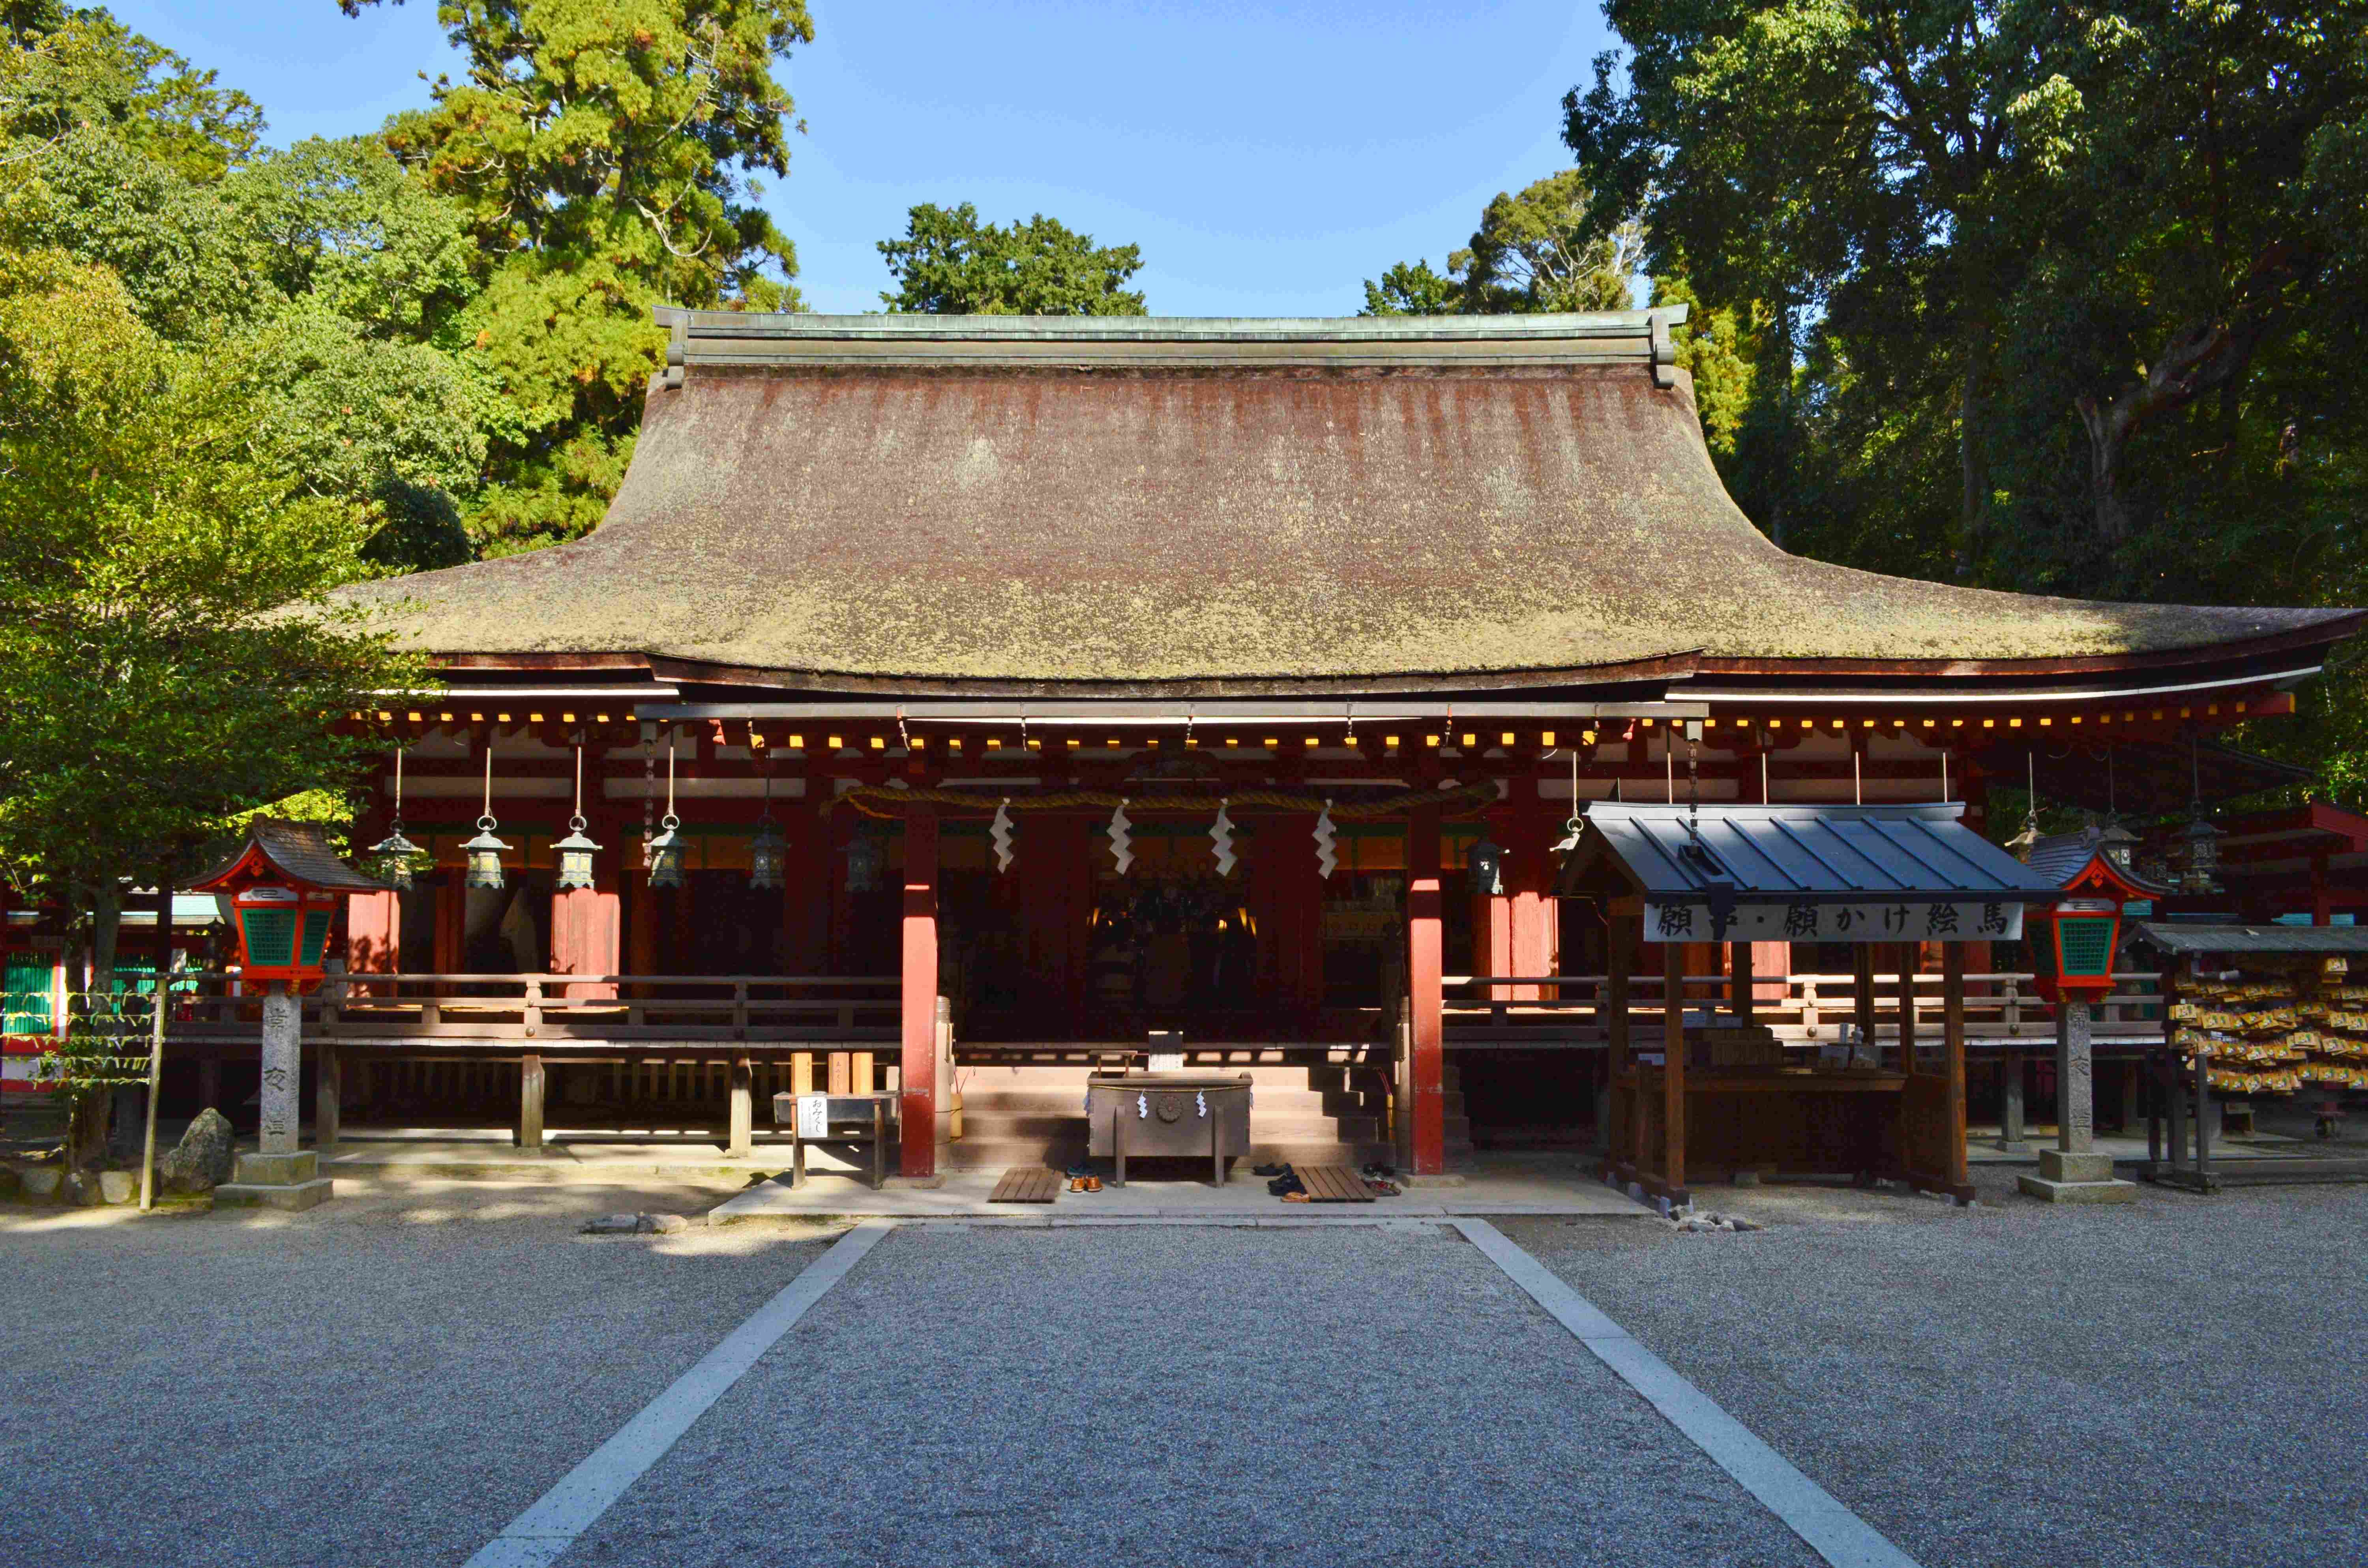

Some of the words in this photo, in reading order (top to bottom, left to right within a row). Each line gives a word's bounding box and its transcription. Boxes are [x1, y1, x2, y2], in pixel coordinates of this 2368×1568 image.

[1657, 903, 2008, 937] 願・願かけ絵馬
[812, 1099, 822, 1133] おみくじ
